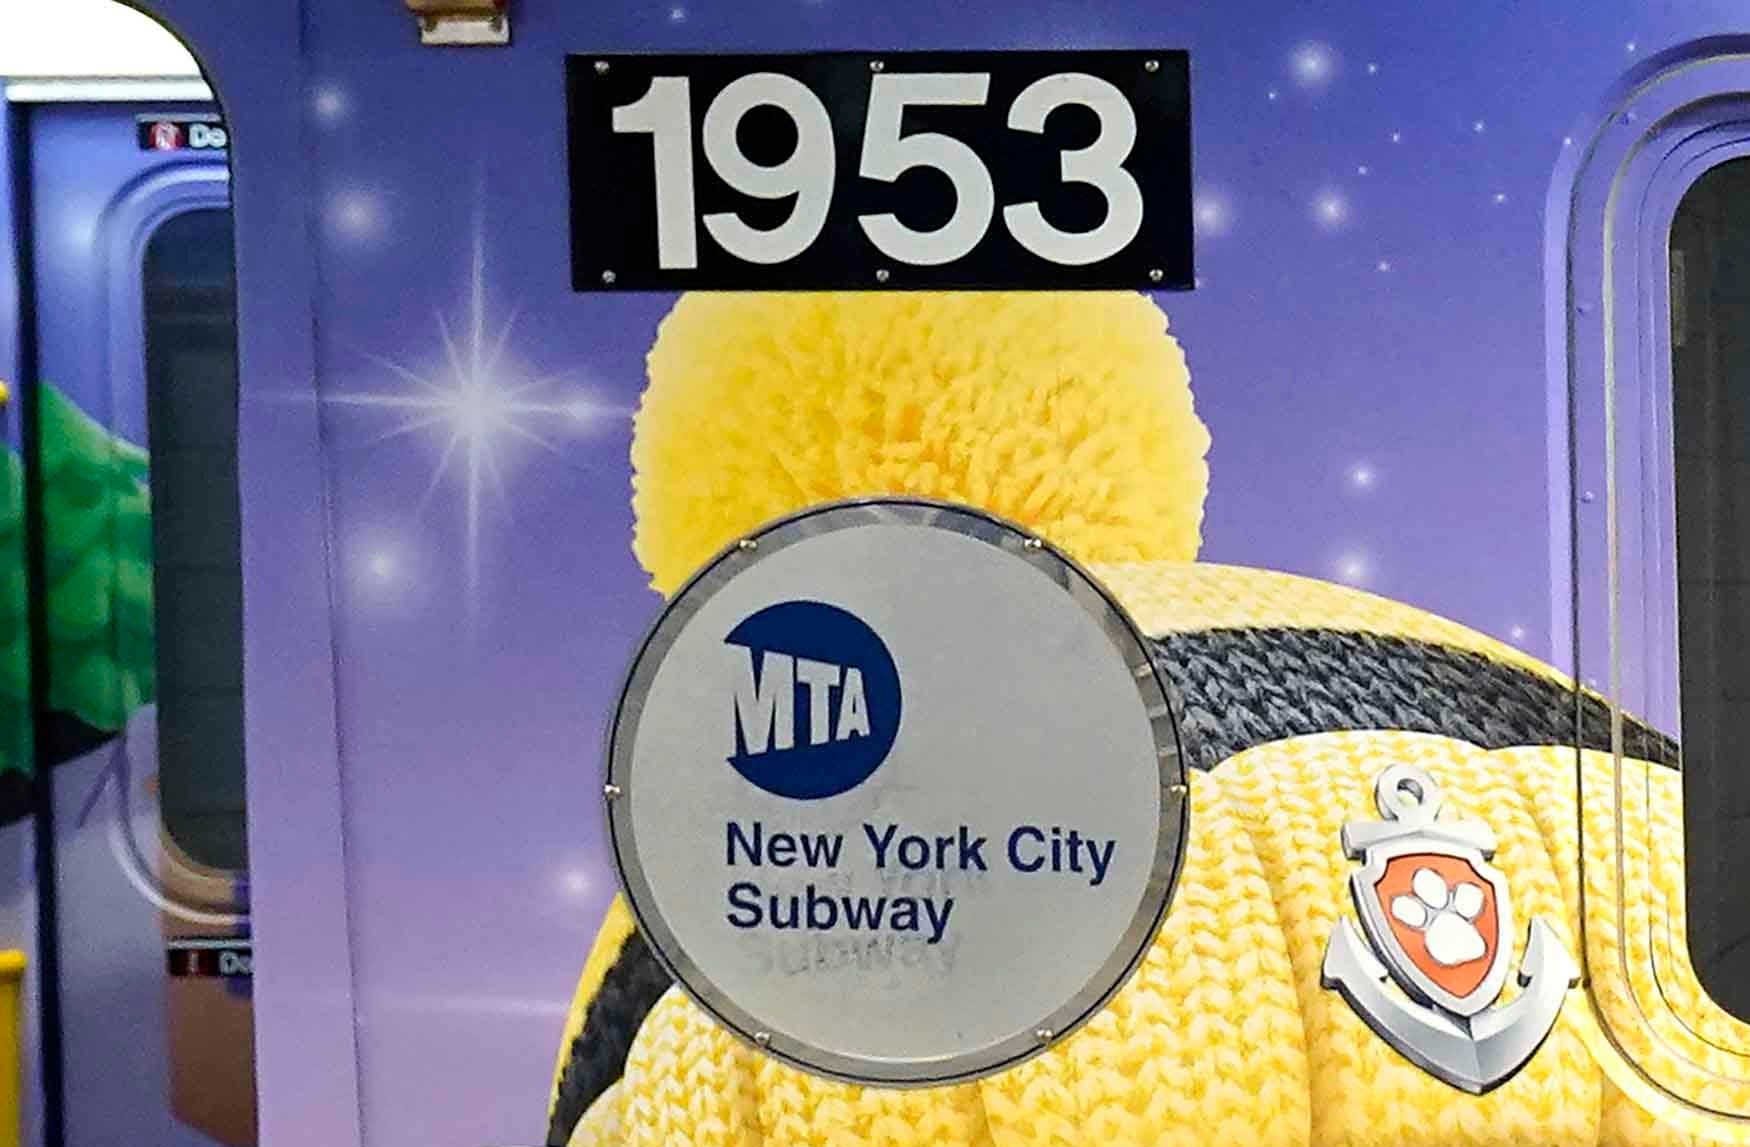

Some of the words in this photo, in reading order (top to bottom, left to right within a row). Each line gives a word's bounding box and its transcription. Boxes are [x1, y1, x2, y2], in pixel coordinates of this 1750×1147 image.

[612, 72, 1144, 270] 1953
[729, 646, 871, 757] MTA
[726, 821, 844, 869] New
[863, 823, 988, 872] York
[1007, 826, 1116, 887] City
[727, 881, 955, 945] Subway
